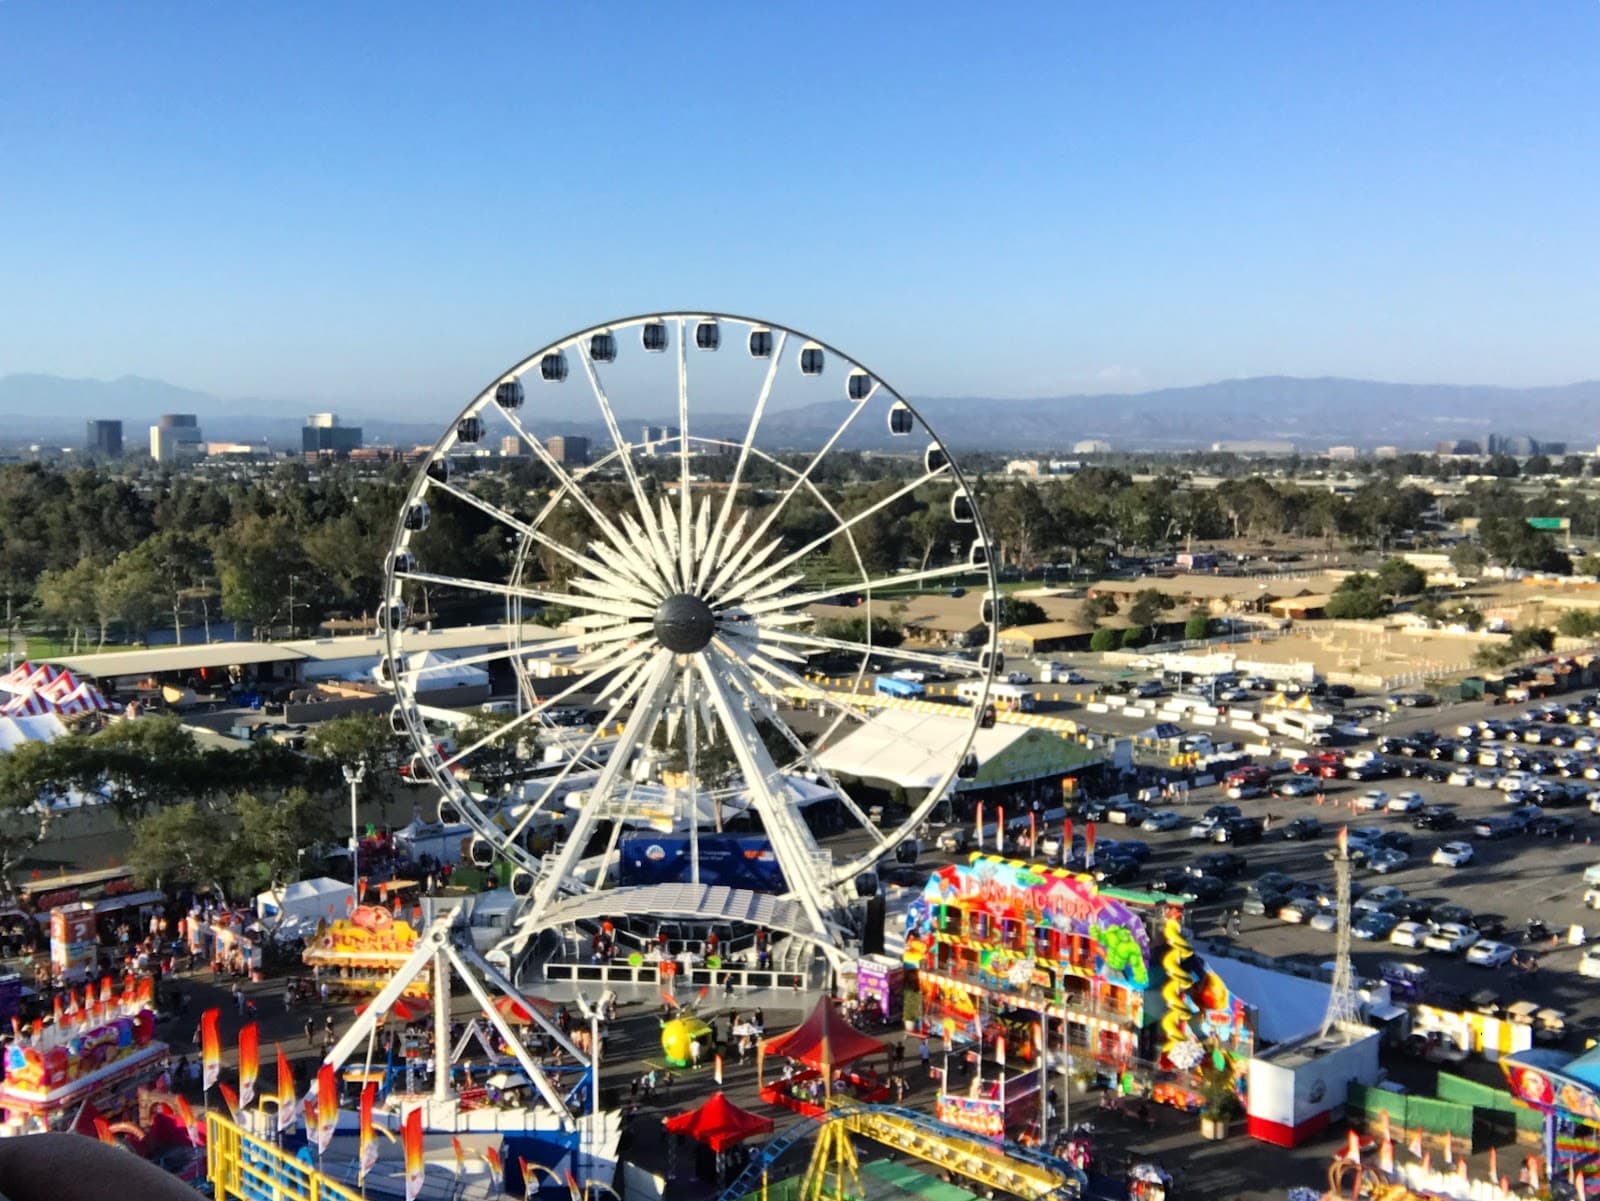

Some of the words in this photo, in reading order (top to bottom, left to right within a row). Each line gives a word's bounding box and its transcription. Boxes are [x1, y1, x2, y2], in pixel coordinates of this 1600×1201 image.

[966, 876, 1006, 899] FUN
[1010, 884, 1103, 922] FACTORY
[332, 932, 396, 948] FUNNEL
